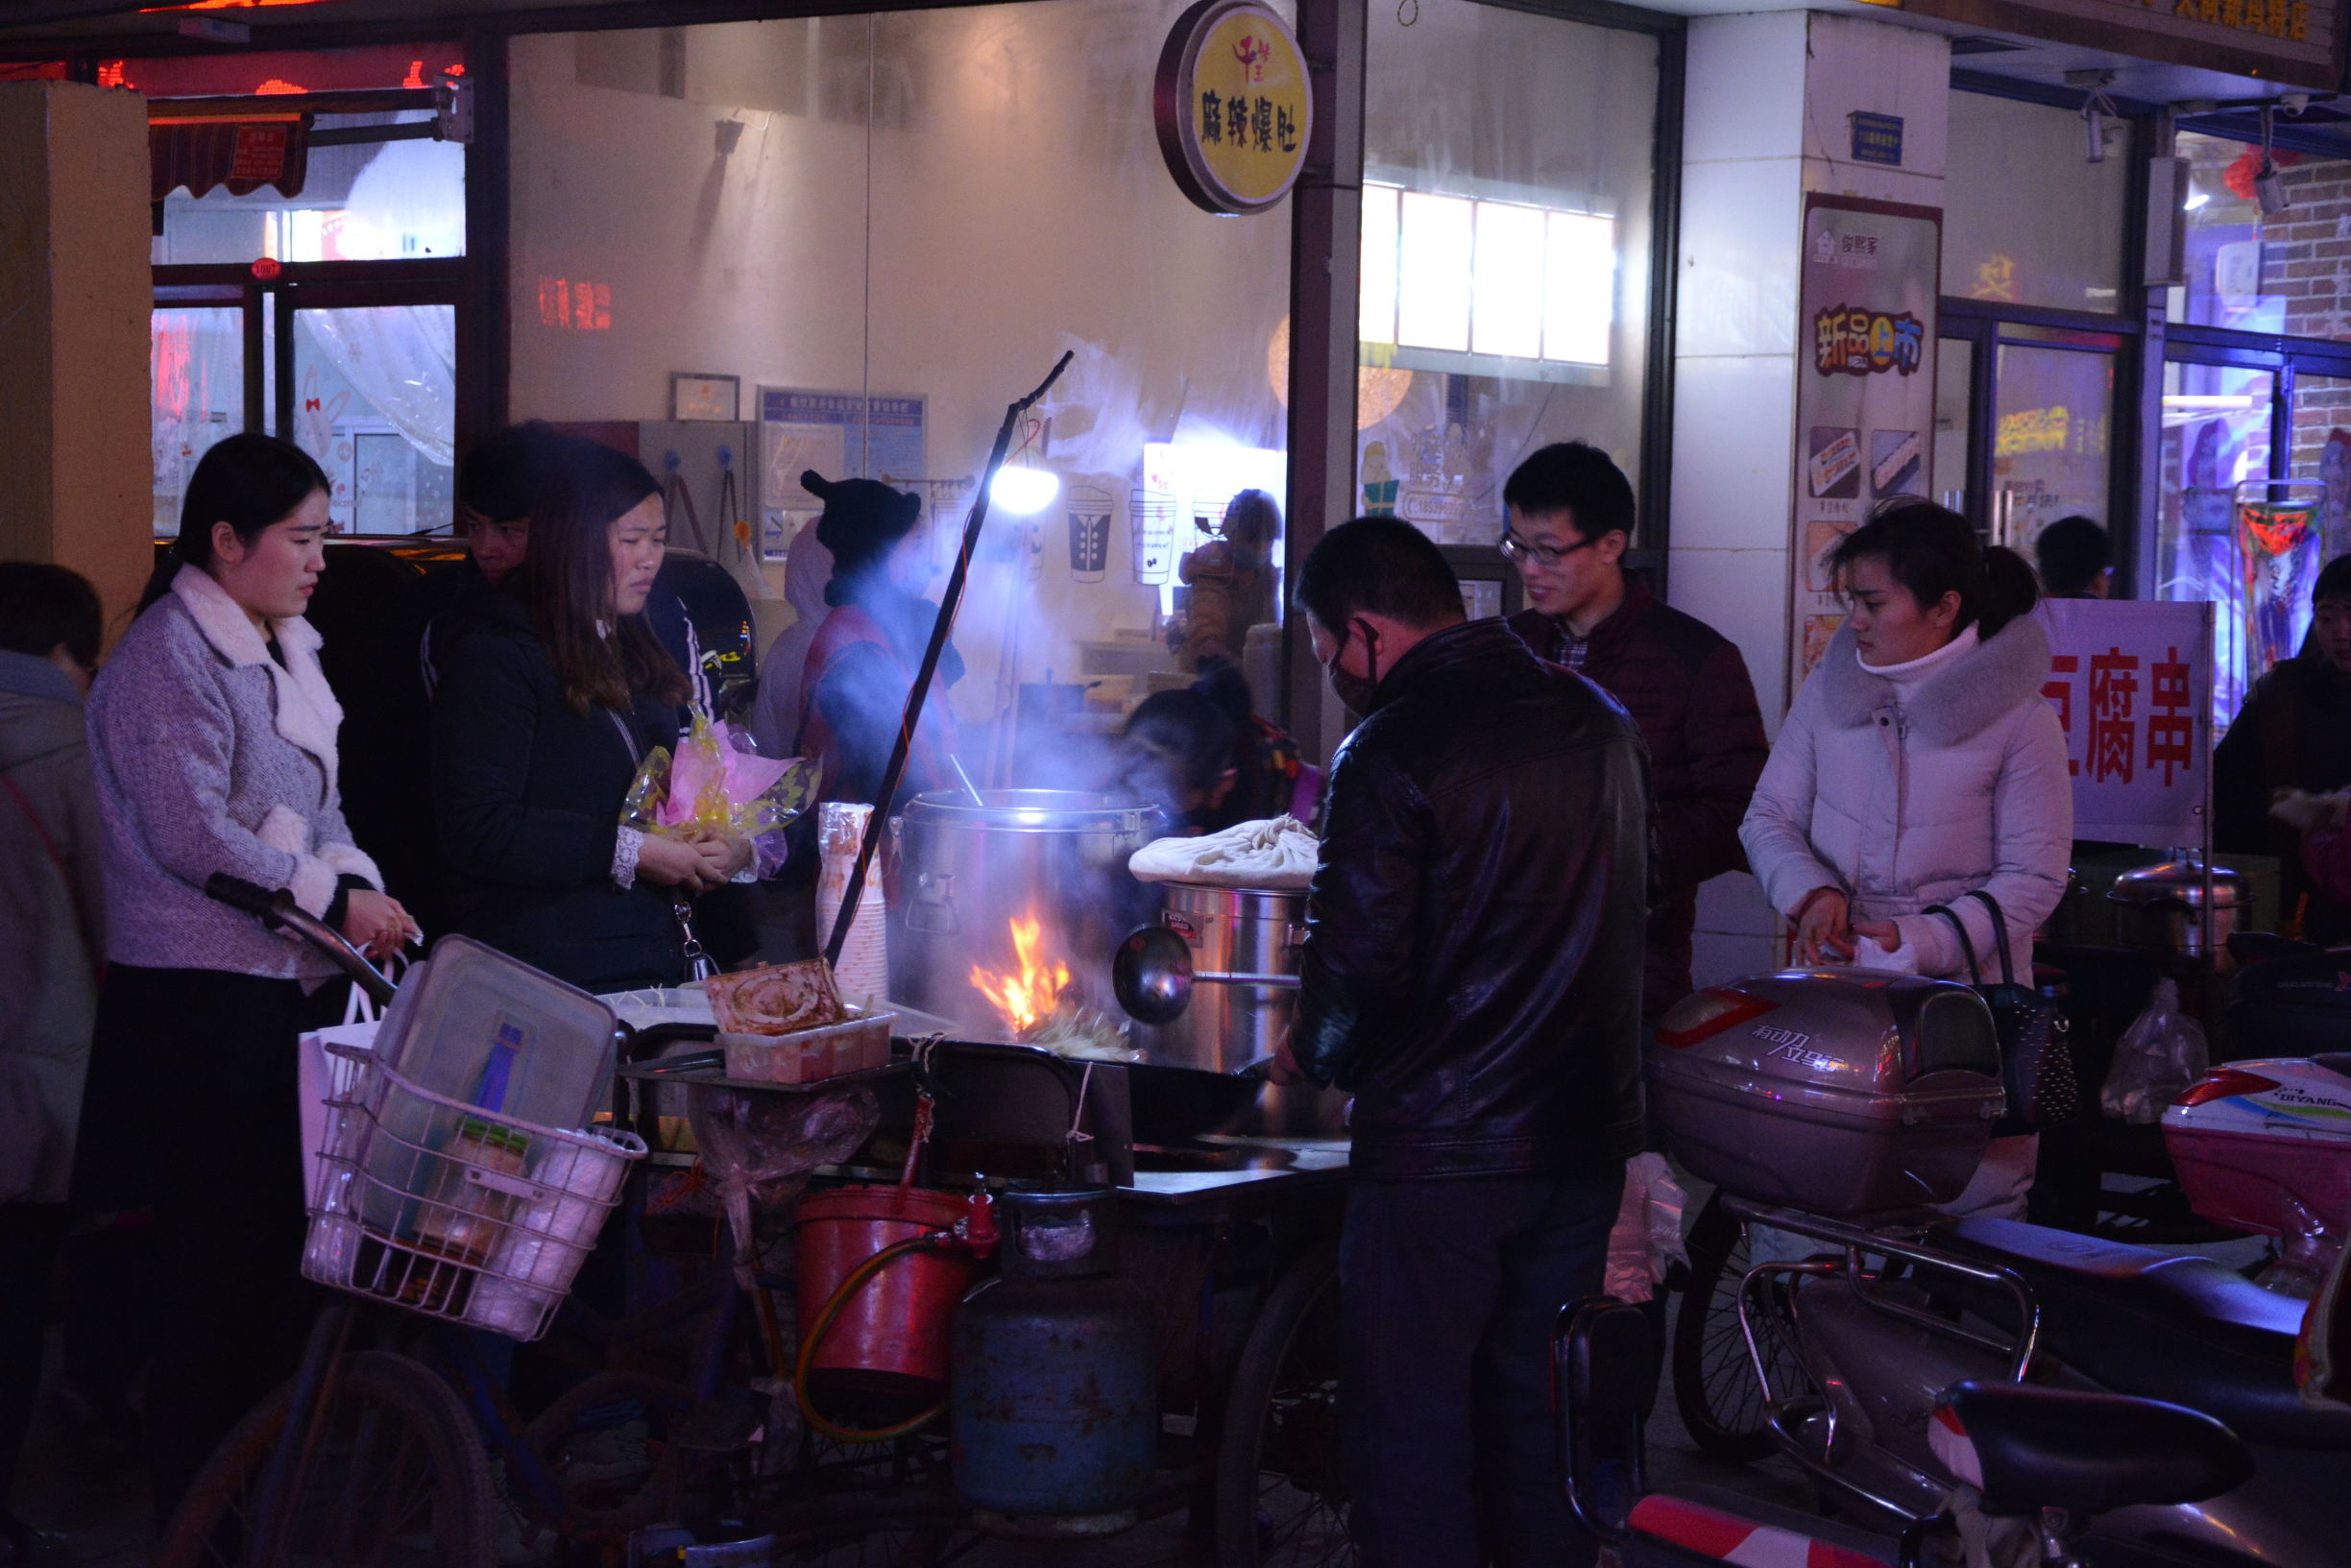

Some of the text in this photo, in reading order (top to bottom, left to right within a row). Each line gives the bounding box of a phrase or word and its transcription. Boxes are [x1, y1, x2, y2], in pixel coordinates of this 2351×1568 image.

[1201, 88, 1296, 153] 麻辣爆肚
[1814, 304, 1923, 375] 新品上市
[1752, 1023, 1809, 1055] 有动力
[2280, 1094, 2337, 1106] DIYANG
